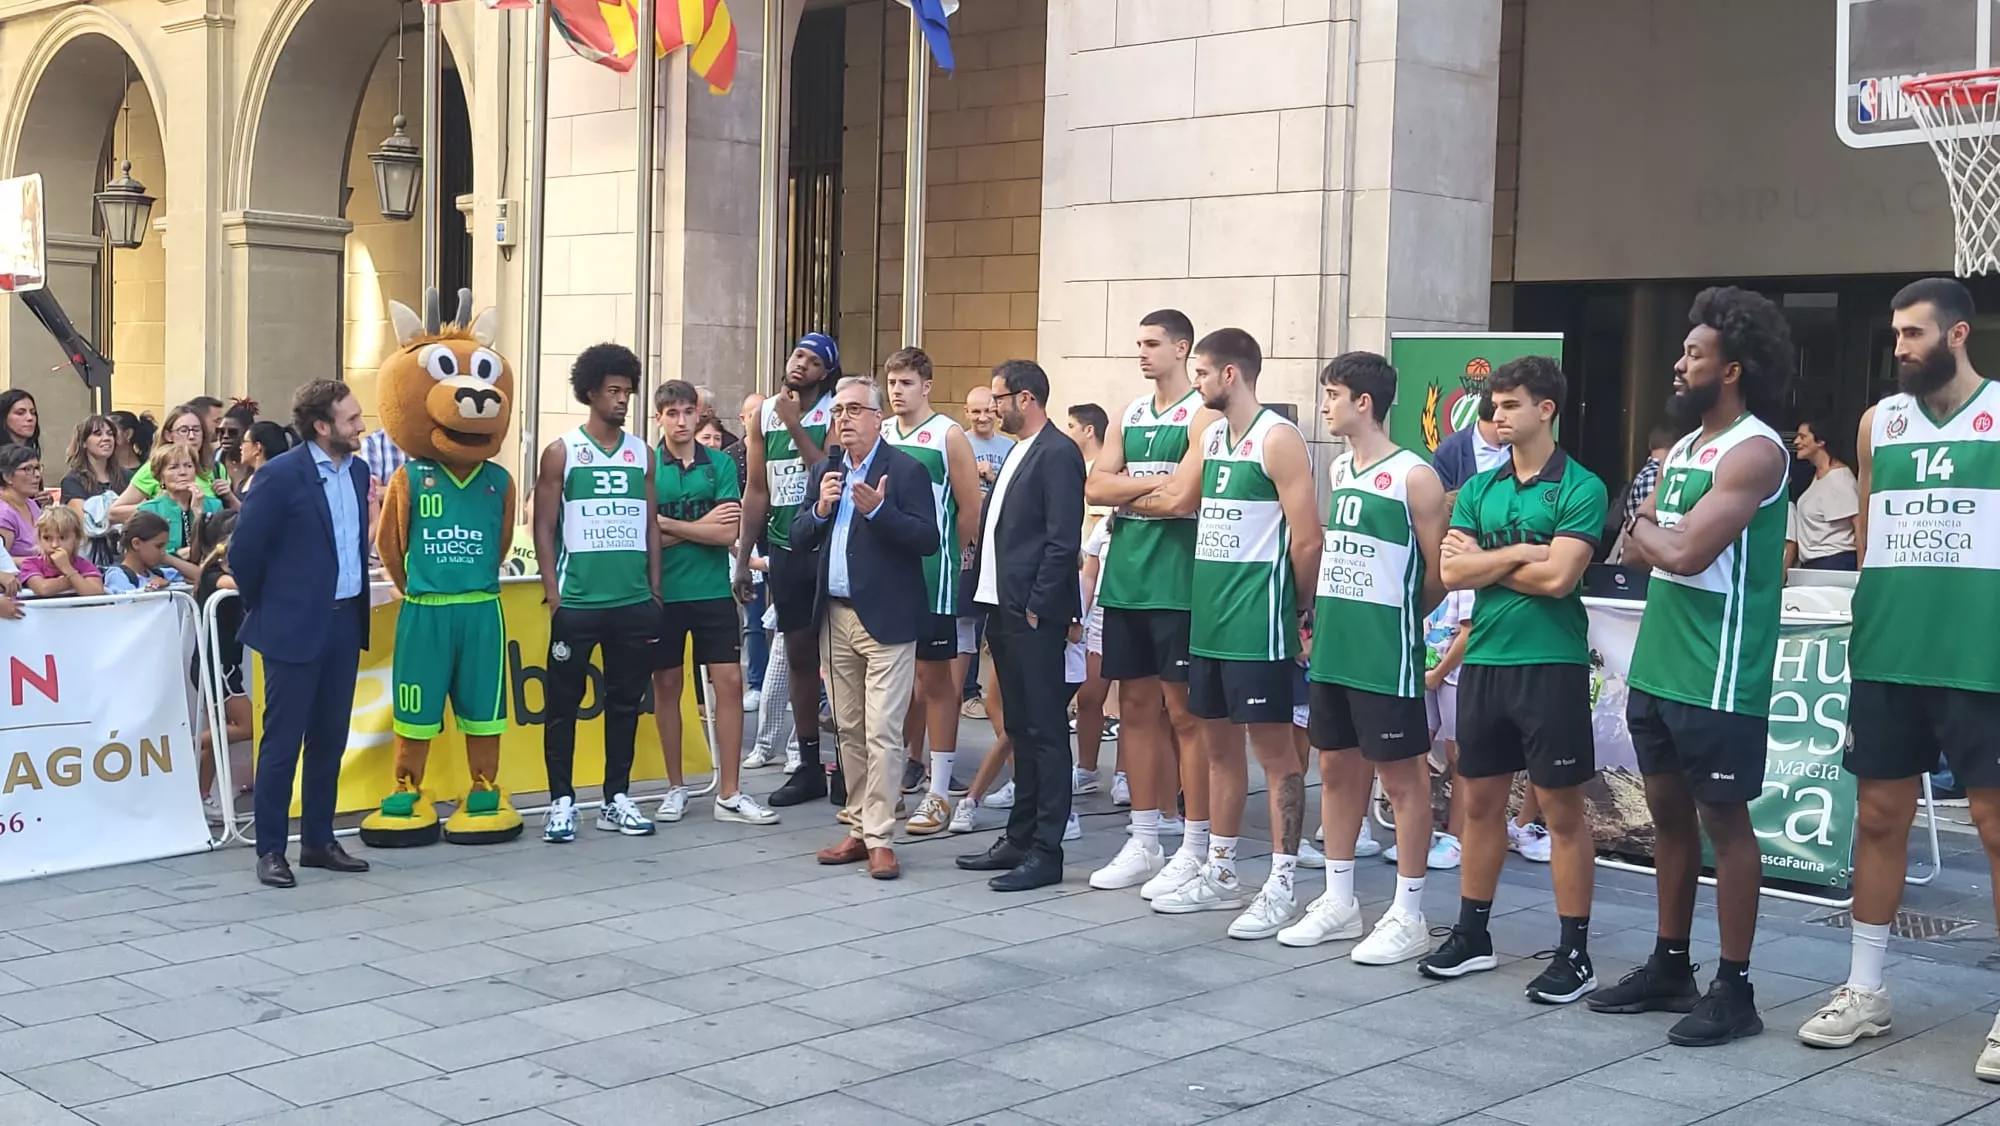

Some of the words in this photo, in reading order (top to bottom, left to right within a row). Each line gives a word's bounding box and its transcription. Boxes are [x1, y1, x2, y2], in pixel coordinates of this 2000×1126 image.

[1144, 430, 1158, 457] 7
[1911, 446, 1954, 483] 14
[592, 470, 629, 495] 33
[420, 493, 443, 518] 00
[581, 501, 640, 517] Lobe
[1335, 495, 1363, 527] 10
[1884, 492, 1976, 516] Lobe
[423, 524, 483, 541] Lobe
[512, 546, 537, 560] MIC
[1772, 637, 1852, 685] Hu
[10, 654, 59, 706] N
[399, 683, 422, 714] 00
[1767, 690, 1848, 756] es
[2, 730, 173, 794] AGÓN
[1760, 854, 1825, 873] escaFauna
